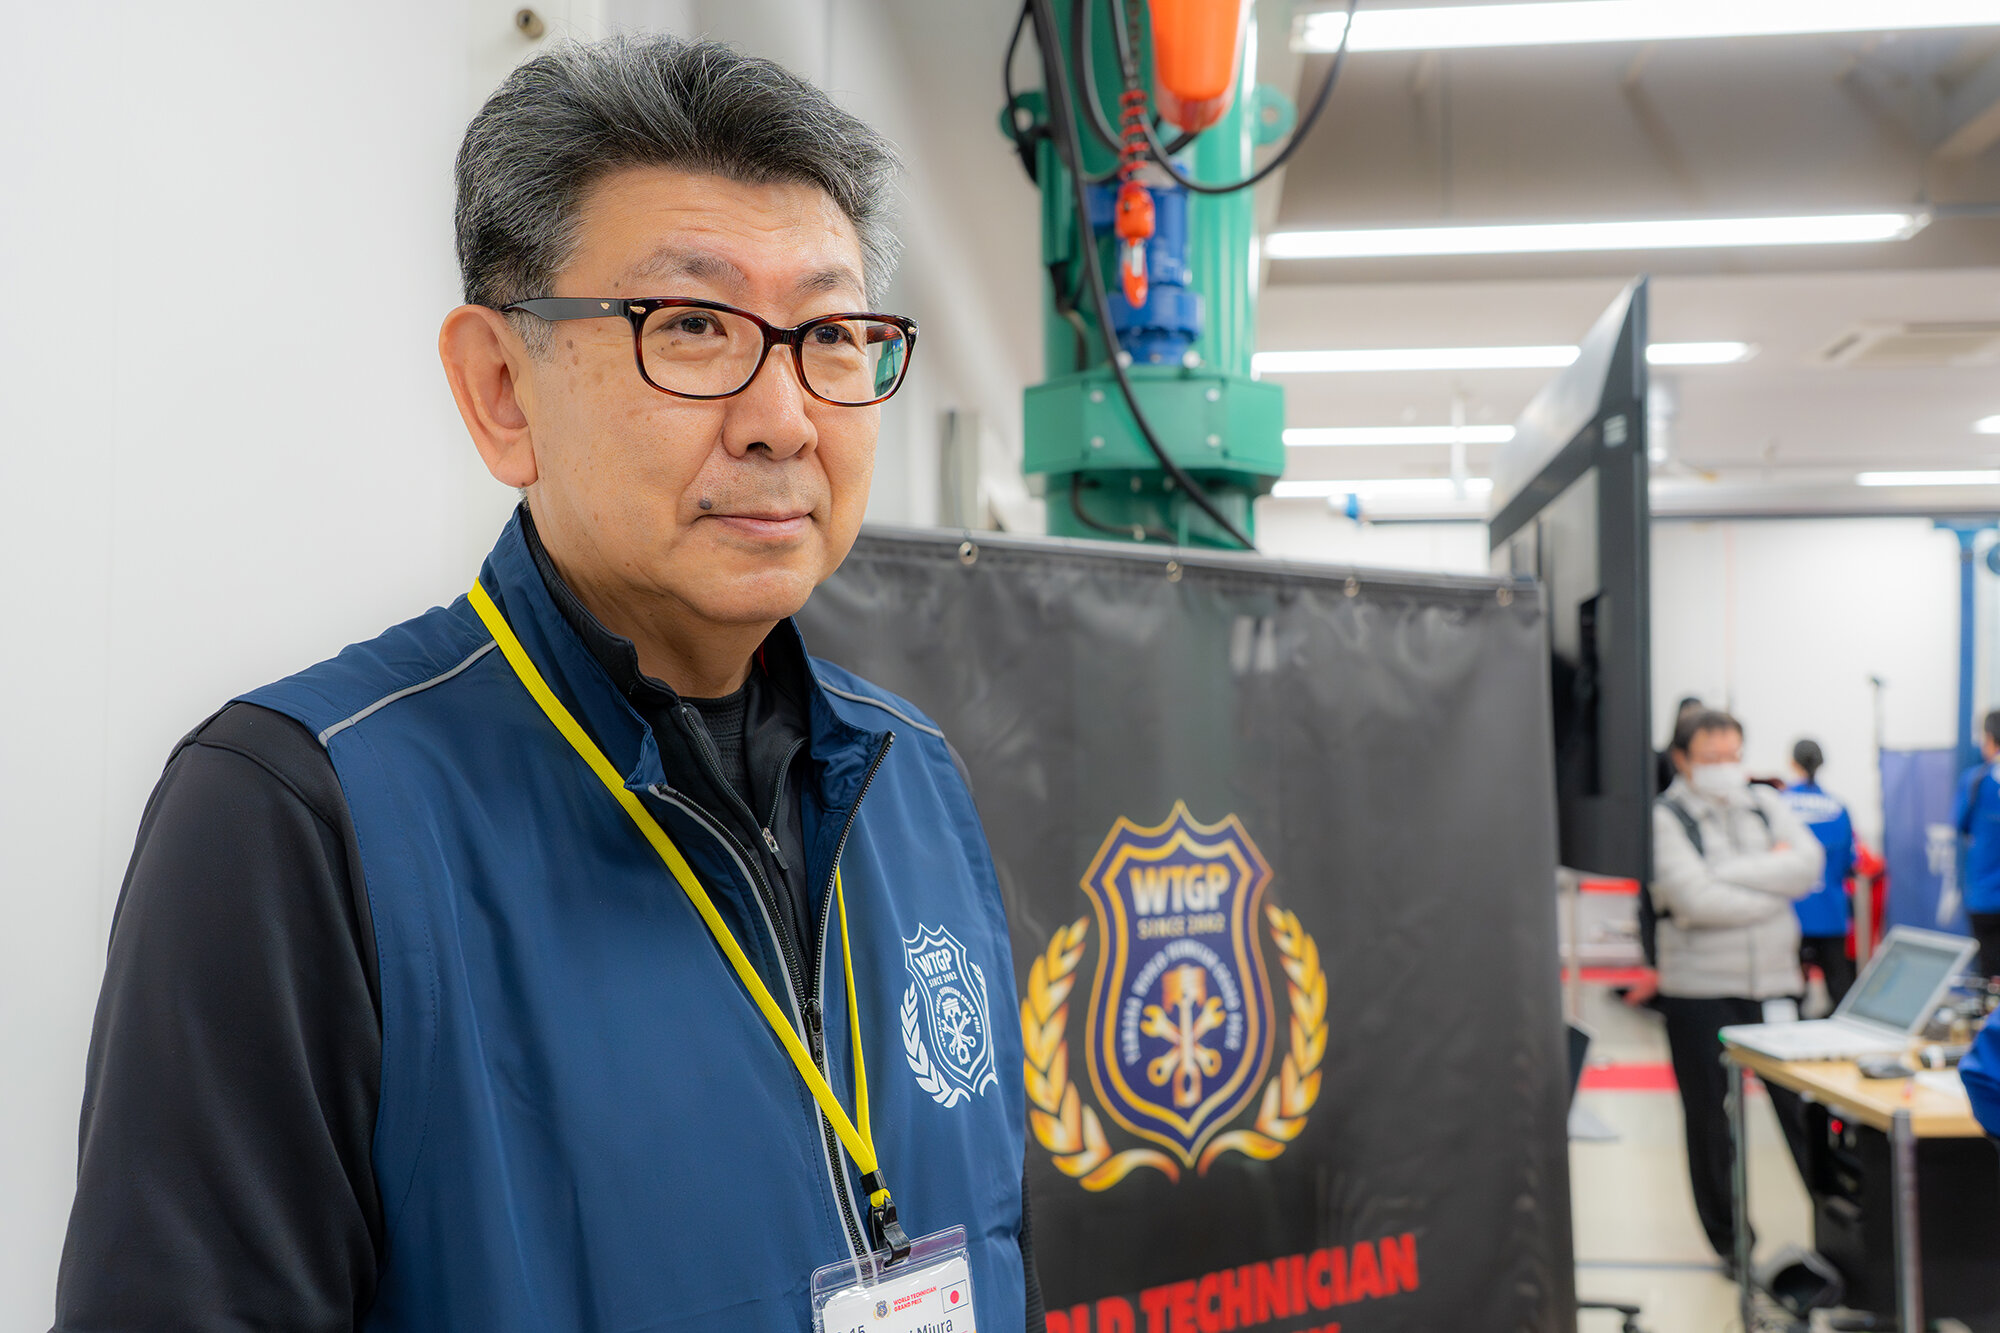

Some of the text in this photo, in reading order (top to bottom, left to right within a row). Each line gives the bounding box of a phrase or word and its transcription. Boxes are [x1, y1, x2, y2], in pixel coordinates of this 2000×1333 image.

[1129, 863, 1231, 915] WTGP
[1136, 916, 1187, 941] SINCE
[914, 948, 952, 977] WTGP
[928, 976, 943, 988] SINCE
[1139, 1232, 1418, 1333] TECHNICIAN
[893, 1286, 937, 1305] WORLD TECHNICIAN
[893, 1298, 922, 1312] GRAND PRIX
